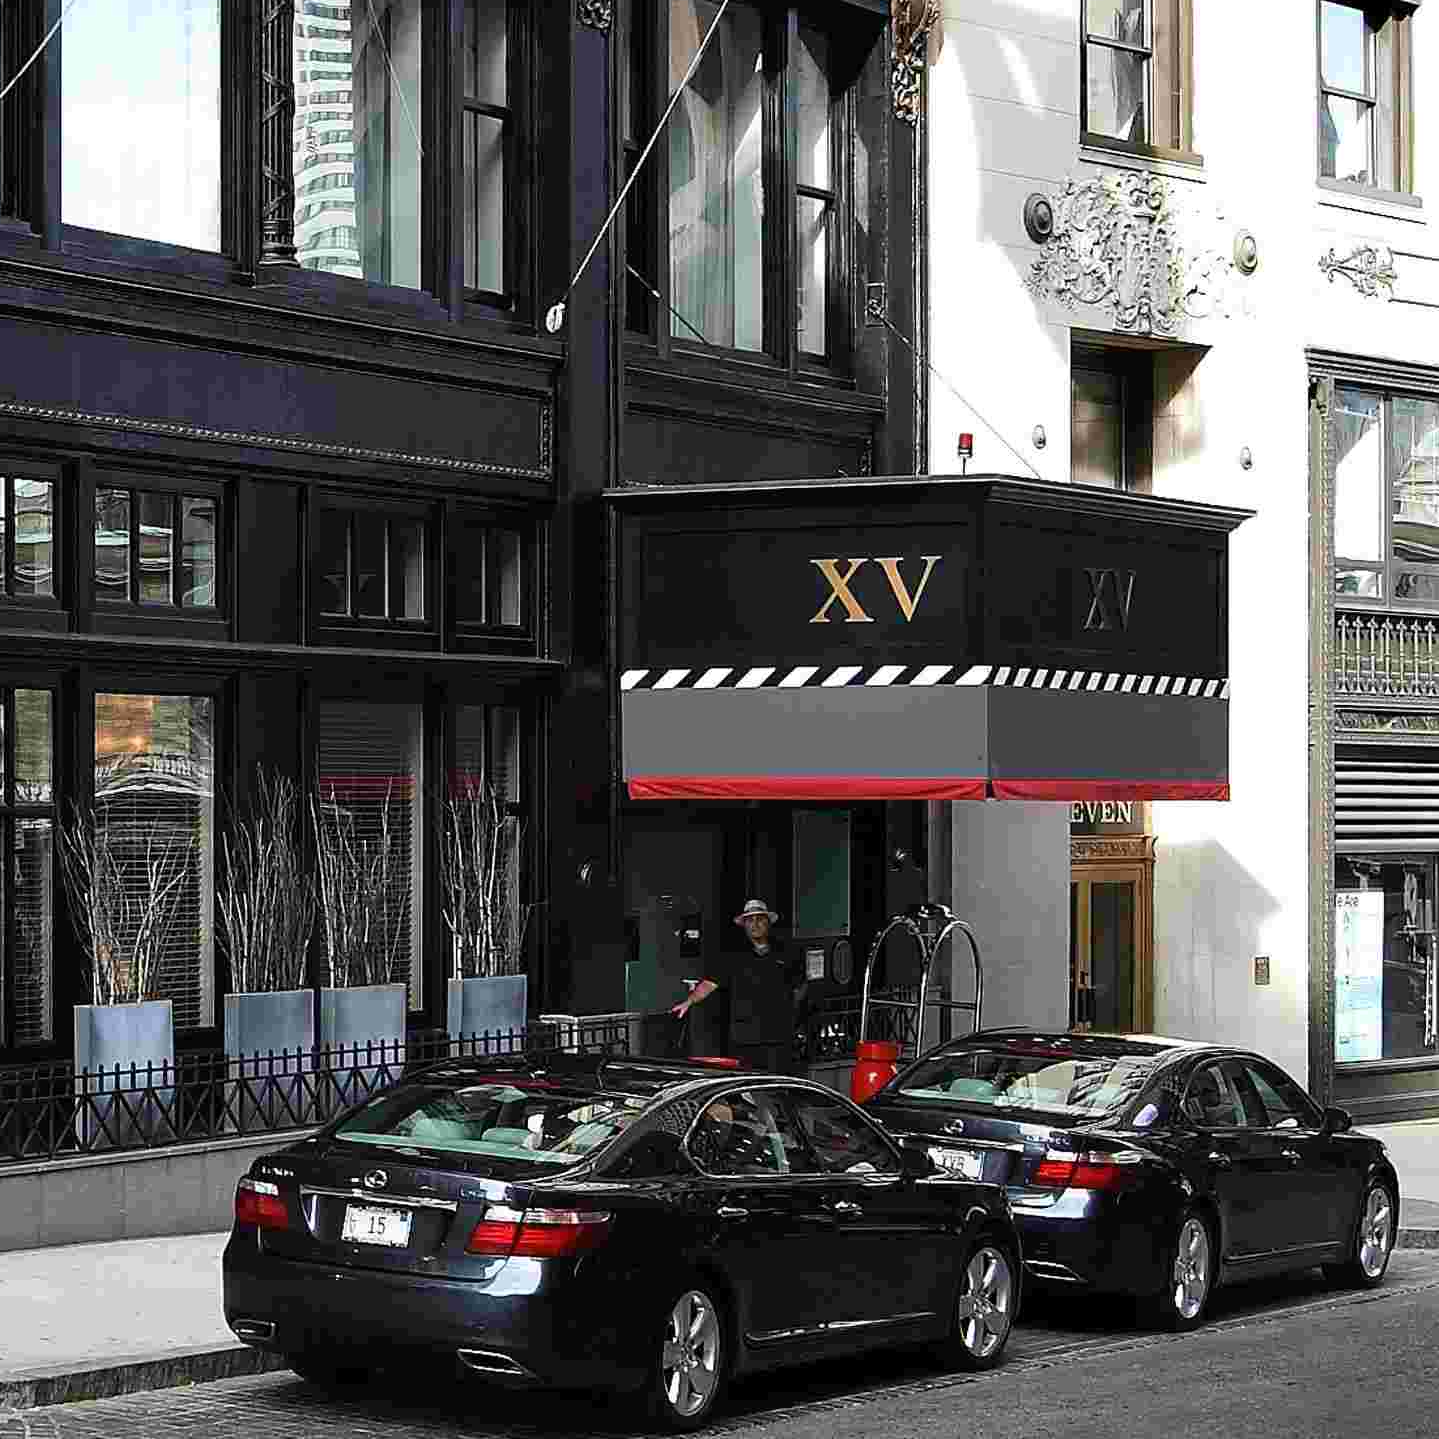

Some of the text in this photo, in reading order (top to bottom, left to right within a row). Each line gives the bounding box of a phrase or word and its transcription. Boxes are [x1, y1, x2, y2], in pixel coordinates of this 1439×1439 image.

[809, 555, 942, 623] XV
[1081, 567, 1136, 633] XV
[368, 1215, 387, 1235] 15
